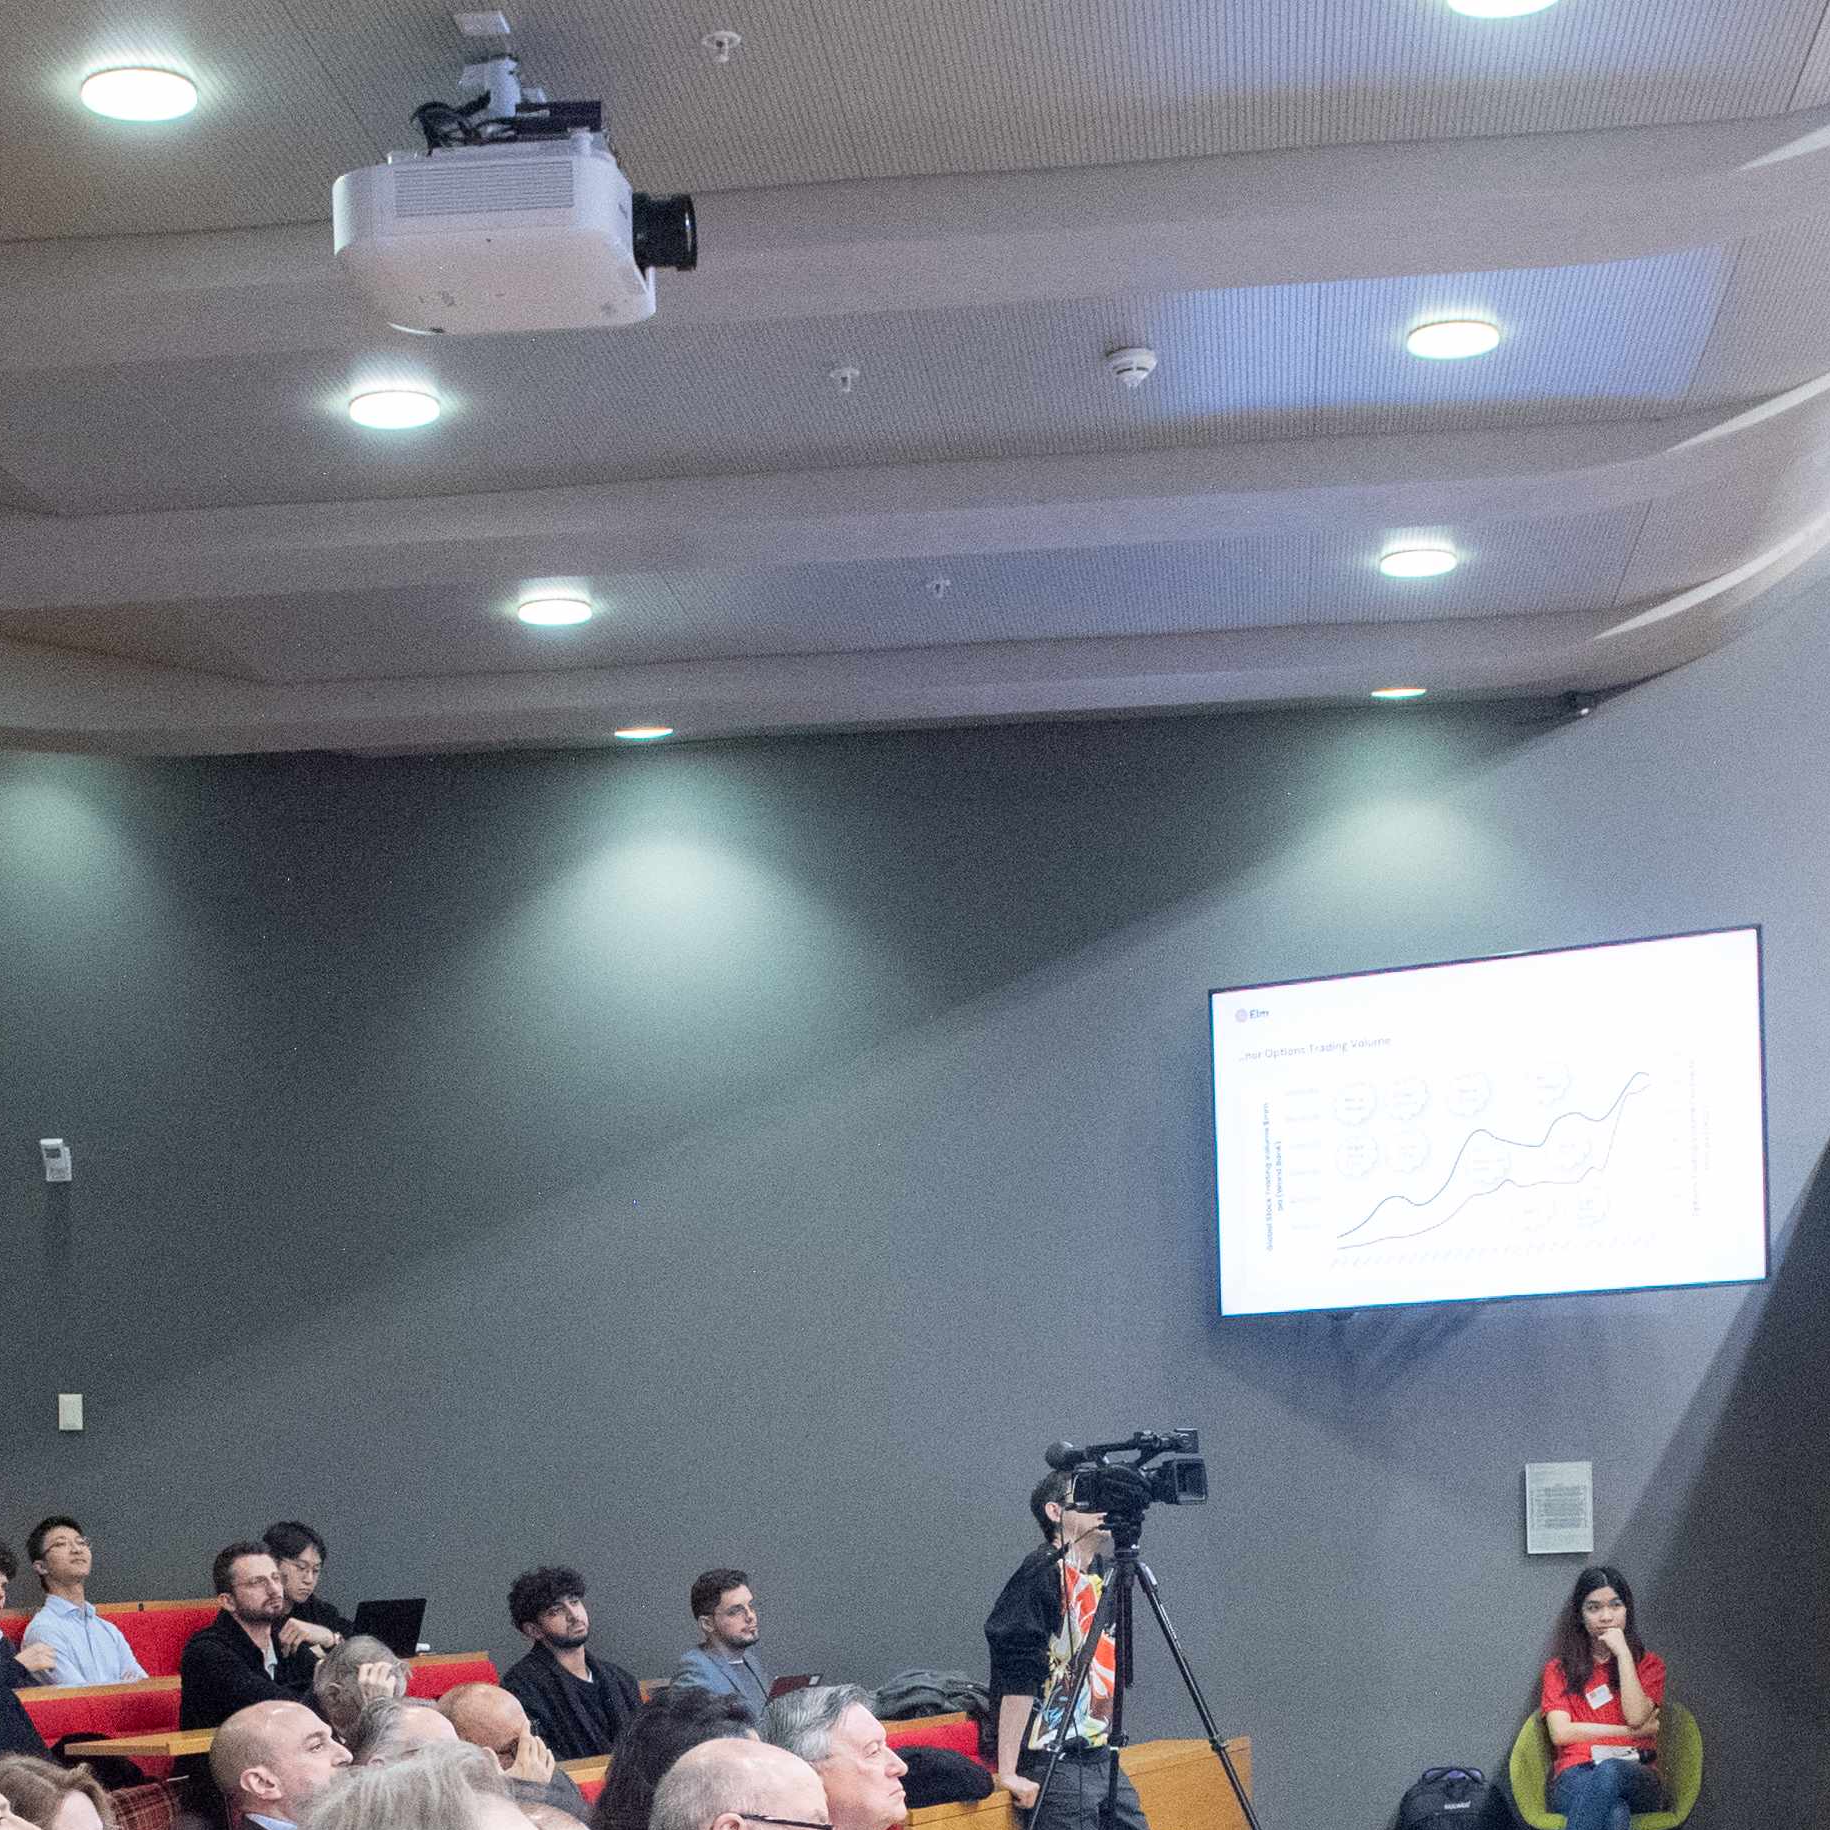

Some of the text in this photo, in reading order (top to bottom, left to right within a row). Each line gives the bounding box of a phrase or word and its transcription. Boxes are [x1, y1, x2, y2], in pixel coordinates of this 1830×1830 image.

[1265, 1046, 1306, 1060] Options
[1308, 1041, 1348, 1055] Trading
[1350, 1036, 1392, 1049] Volume
